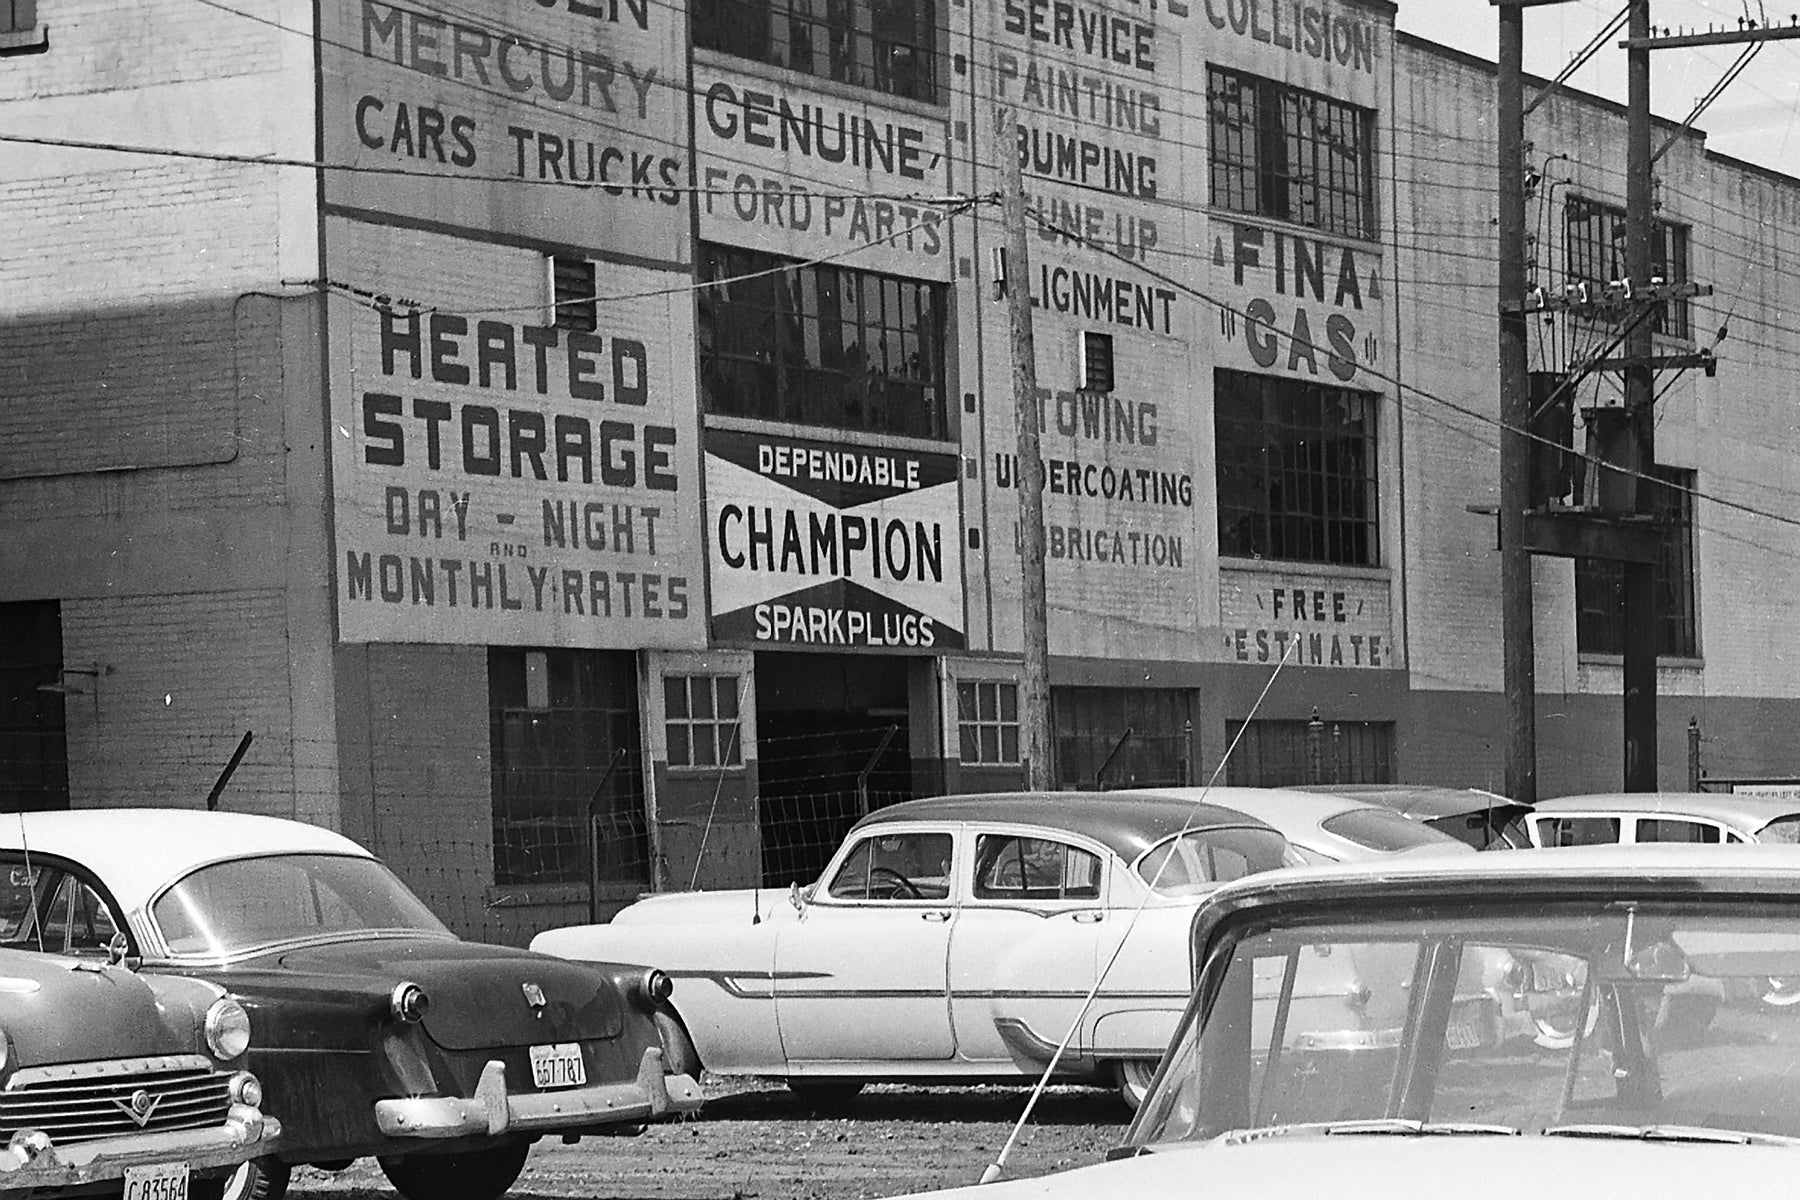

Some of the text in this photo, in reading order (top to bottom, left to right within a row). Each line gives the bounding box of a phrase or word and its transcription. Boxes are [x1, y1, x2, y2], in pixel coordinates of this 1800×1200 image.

[362, 6, 658, 119] MERCURY
[1005, 0, 1154, 71] SERVICE
[705, 82, 924, 180] GENUINE
[1000, 52, 1160, 138] PAINTING
[355, 95, 682, 206] CARS TRUCKS
[705, 167, 942, 255] FORD PARTS
[1030, 195, 1158, 262] UNE UP
[1233, 224, 1363, 310] FINA
[379, 305, 648, 406] HEATED
[1245, 298, 1357, 382] GAS
[362, 391, 678, 492] STORAGE
[1035, 387, 1158, 447] TOWING
[758, 444, 921, 489] DEPENDABLE
[385, 486, 471, 541] DAY
[542, 499, 661, 556] NIGHT
[489, 542, 528, 558] AND
[718, 504, 943, 583] CHAMPION
[1014, 521, 1183, 568] LBRICATION
[347, 550, 688, 619] MONTHLY RATES
[1272, 588, 1346, 622] FREE
[1235, 629, 1382, 667] ESTIMATE
